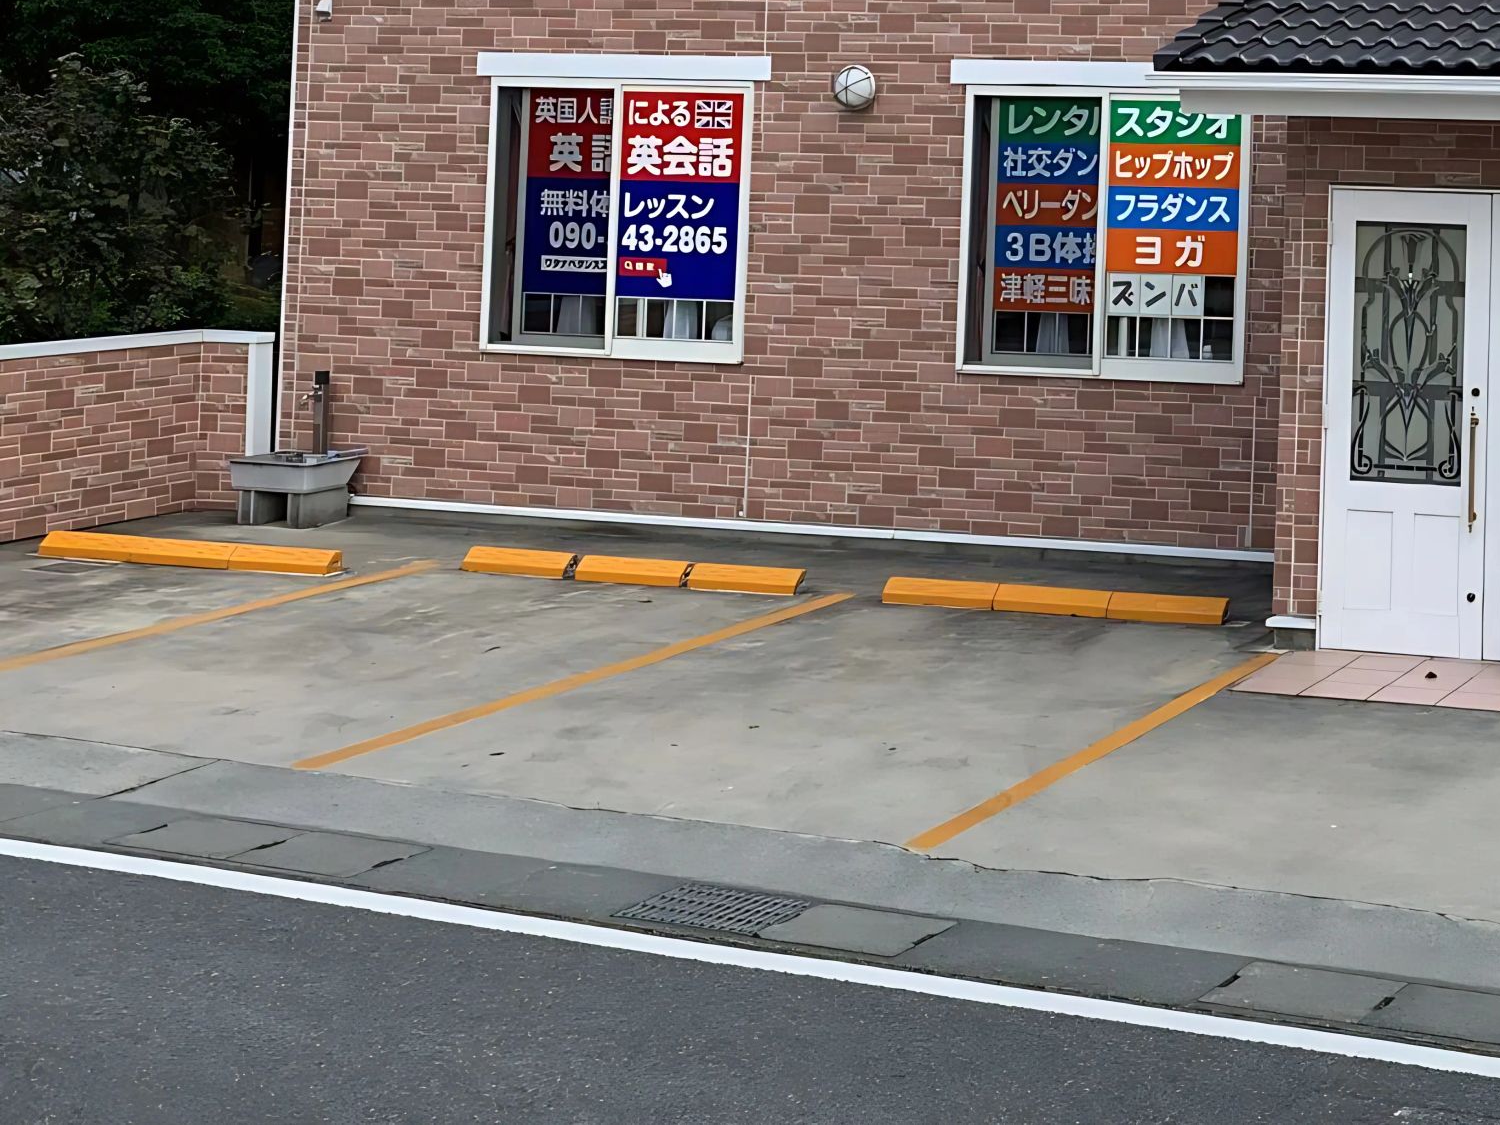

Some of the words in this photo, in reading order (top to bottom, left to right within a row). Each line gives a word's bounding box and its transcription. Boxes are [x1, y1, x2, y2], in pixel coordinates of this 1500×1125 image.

[629, 98, 691, 126] による
[1115, 106, 1236, 139] スタジオ
[627, 134, 734, 177] 英会話
[1003, 146, 1098, 177] 社交ダン
[1115, 150, 1234, 180] ヒップホップ
[623, 191, 714, 219] レッスン
[1114, 193, 1231, 223] フラダンス
[621, 224, 728, 254] 43-2865
[1135, 235, 1206, 268] ヨガ
[1112, 280, 1199, 307] ズンバ
